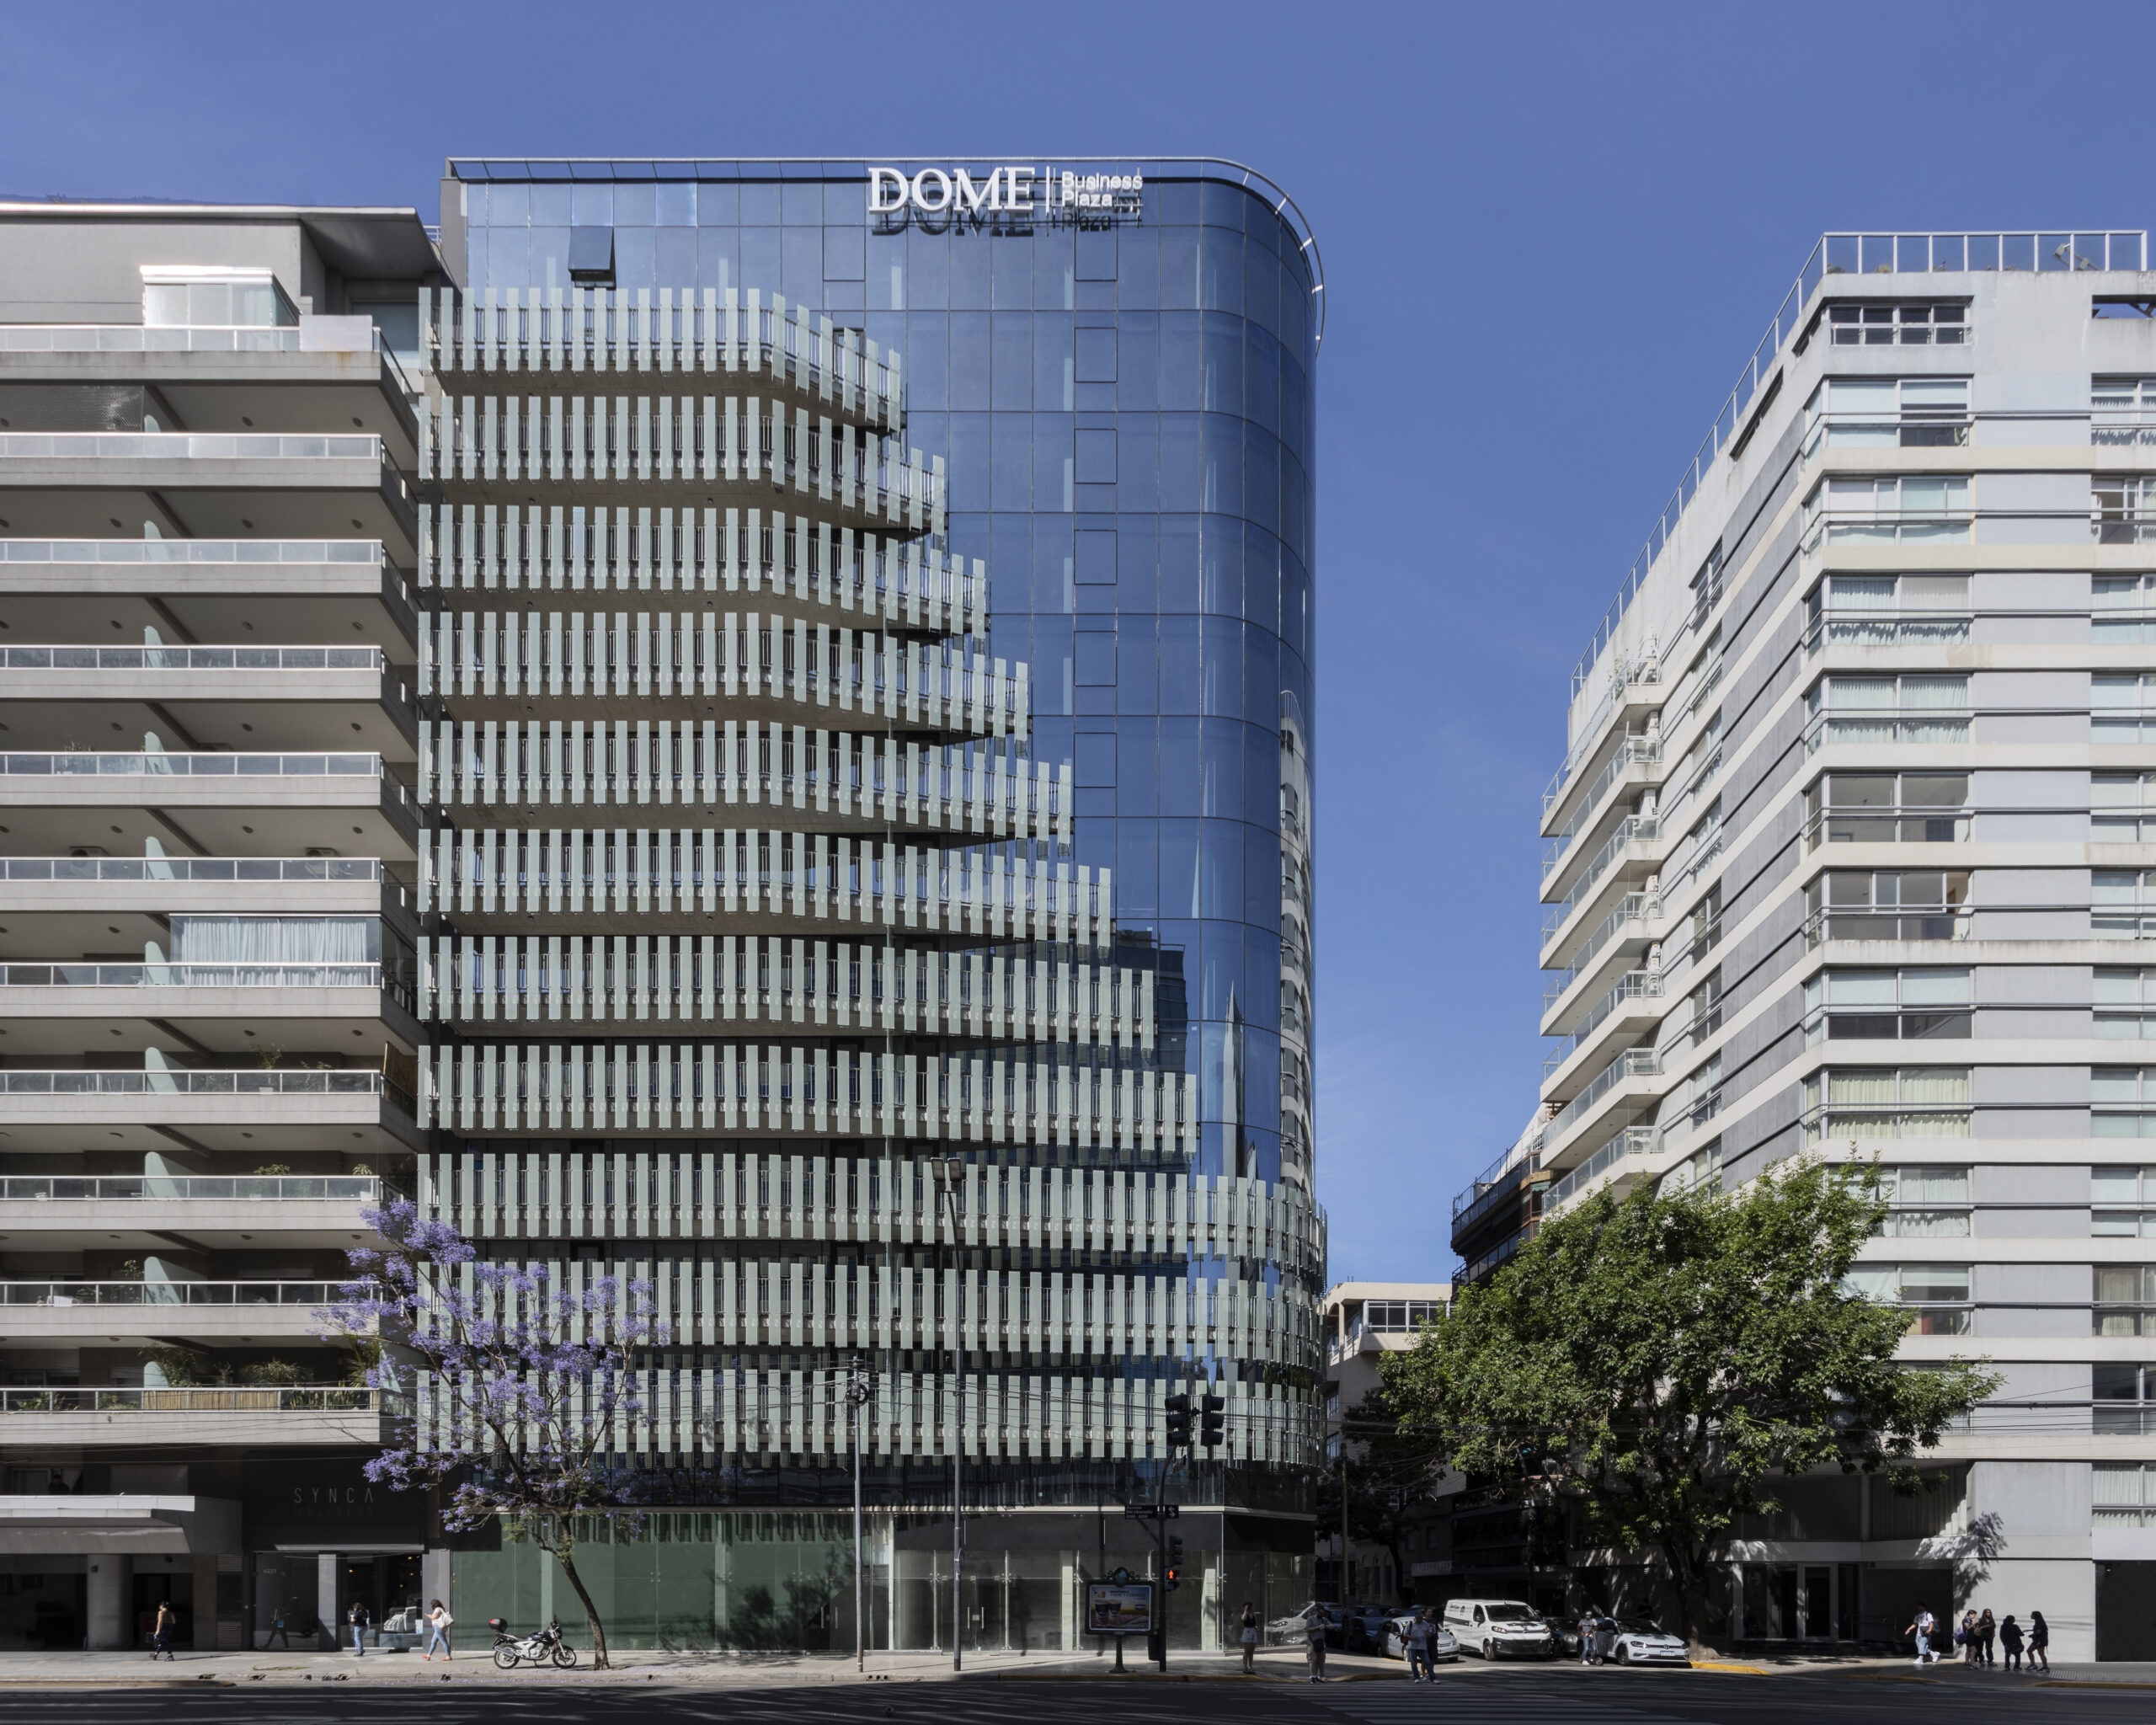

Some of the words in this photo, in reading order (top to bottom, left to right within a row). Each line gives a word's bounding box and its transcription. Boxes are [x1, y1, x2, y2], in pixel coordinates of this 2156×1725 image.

[867, 167, 1035, 214] DOME
[1061, 171, 1143, 193] Business
[1061, 190, 1113, 209] Plaza
[294, 1487, 374, 1503] SYNCA
